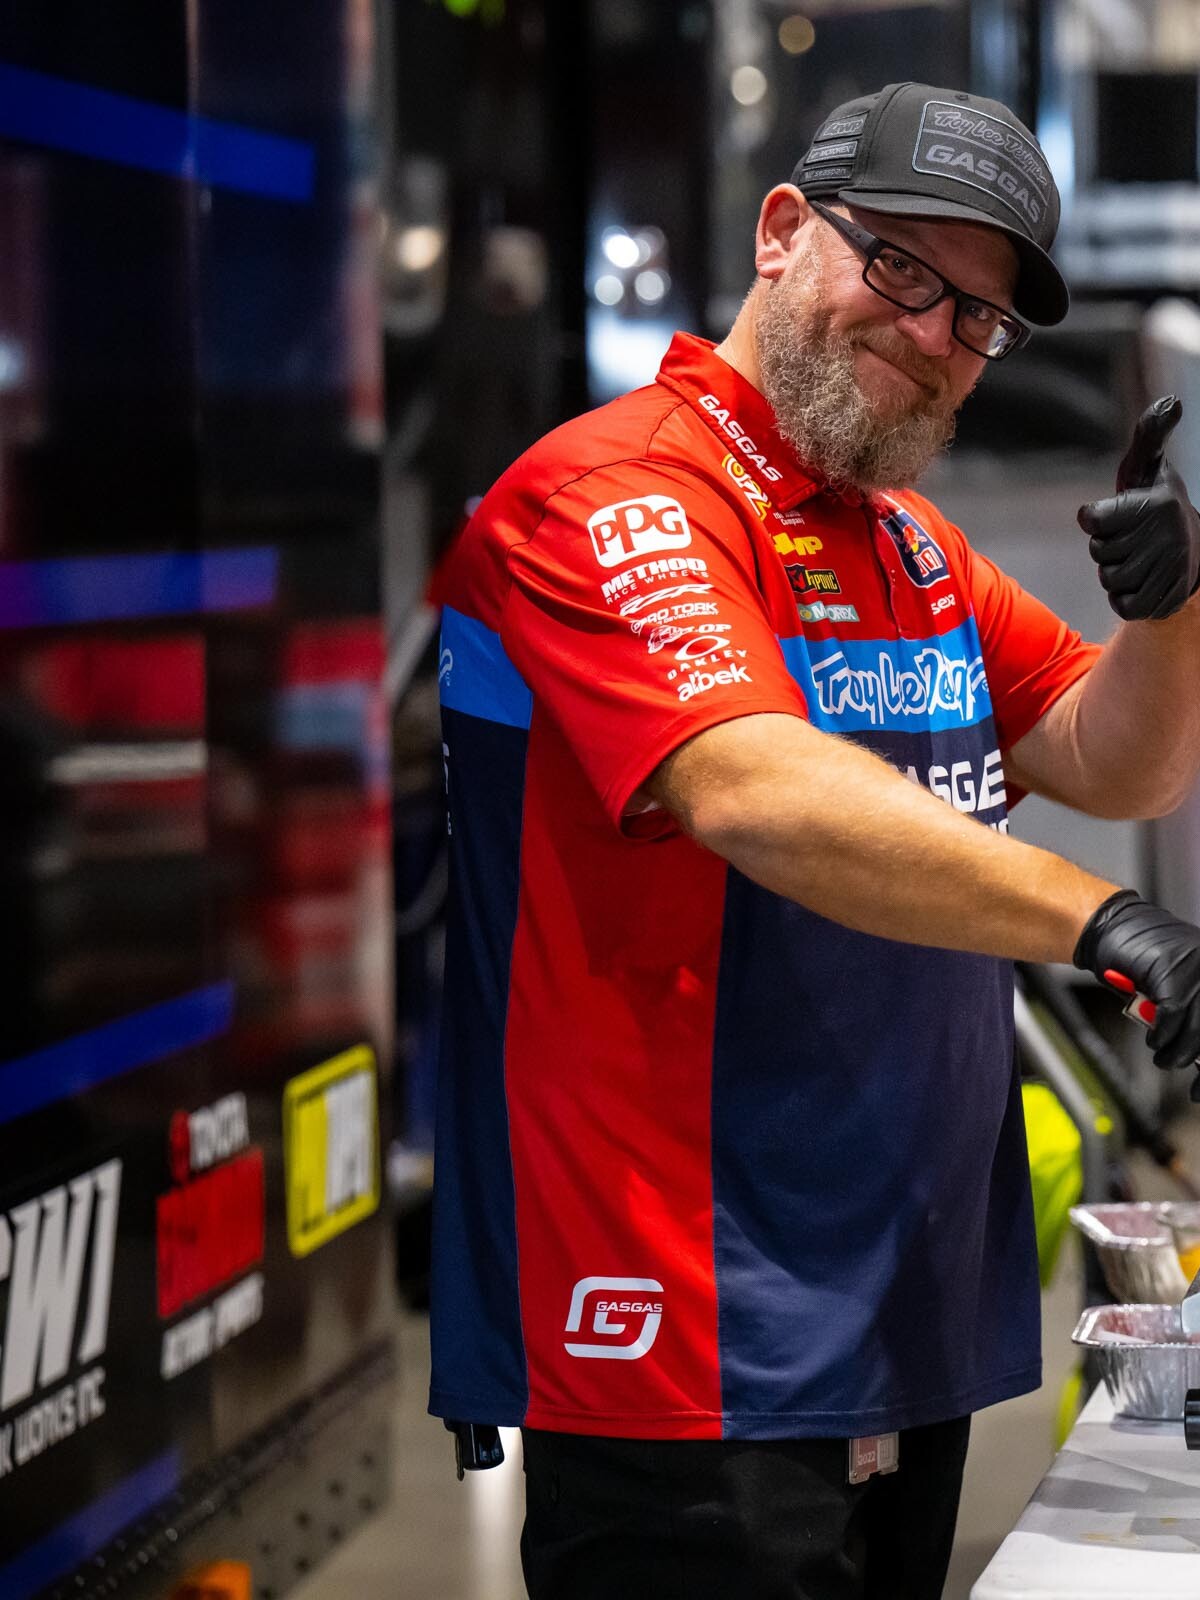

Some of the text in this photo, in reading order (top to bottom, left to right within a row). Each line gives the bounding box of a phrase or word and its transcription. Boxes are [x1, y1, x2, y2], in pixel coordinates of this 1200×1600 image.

[925, 144, 1041, 223] GASGAS
[698, 394, 784, 482] GASGAS
[592, 503, 685, 557] PPG
[600, 557, 708, 599] METHOD
[606, 583, 637, 605] RACE
[667, 650, 747, 681] OAKLEY
[596, 1301, 662, 1313] GASGAS
